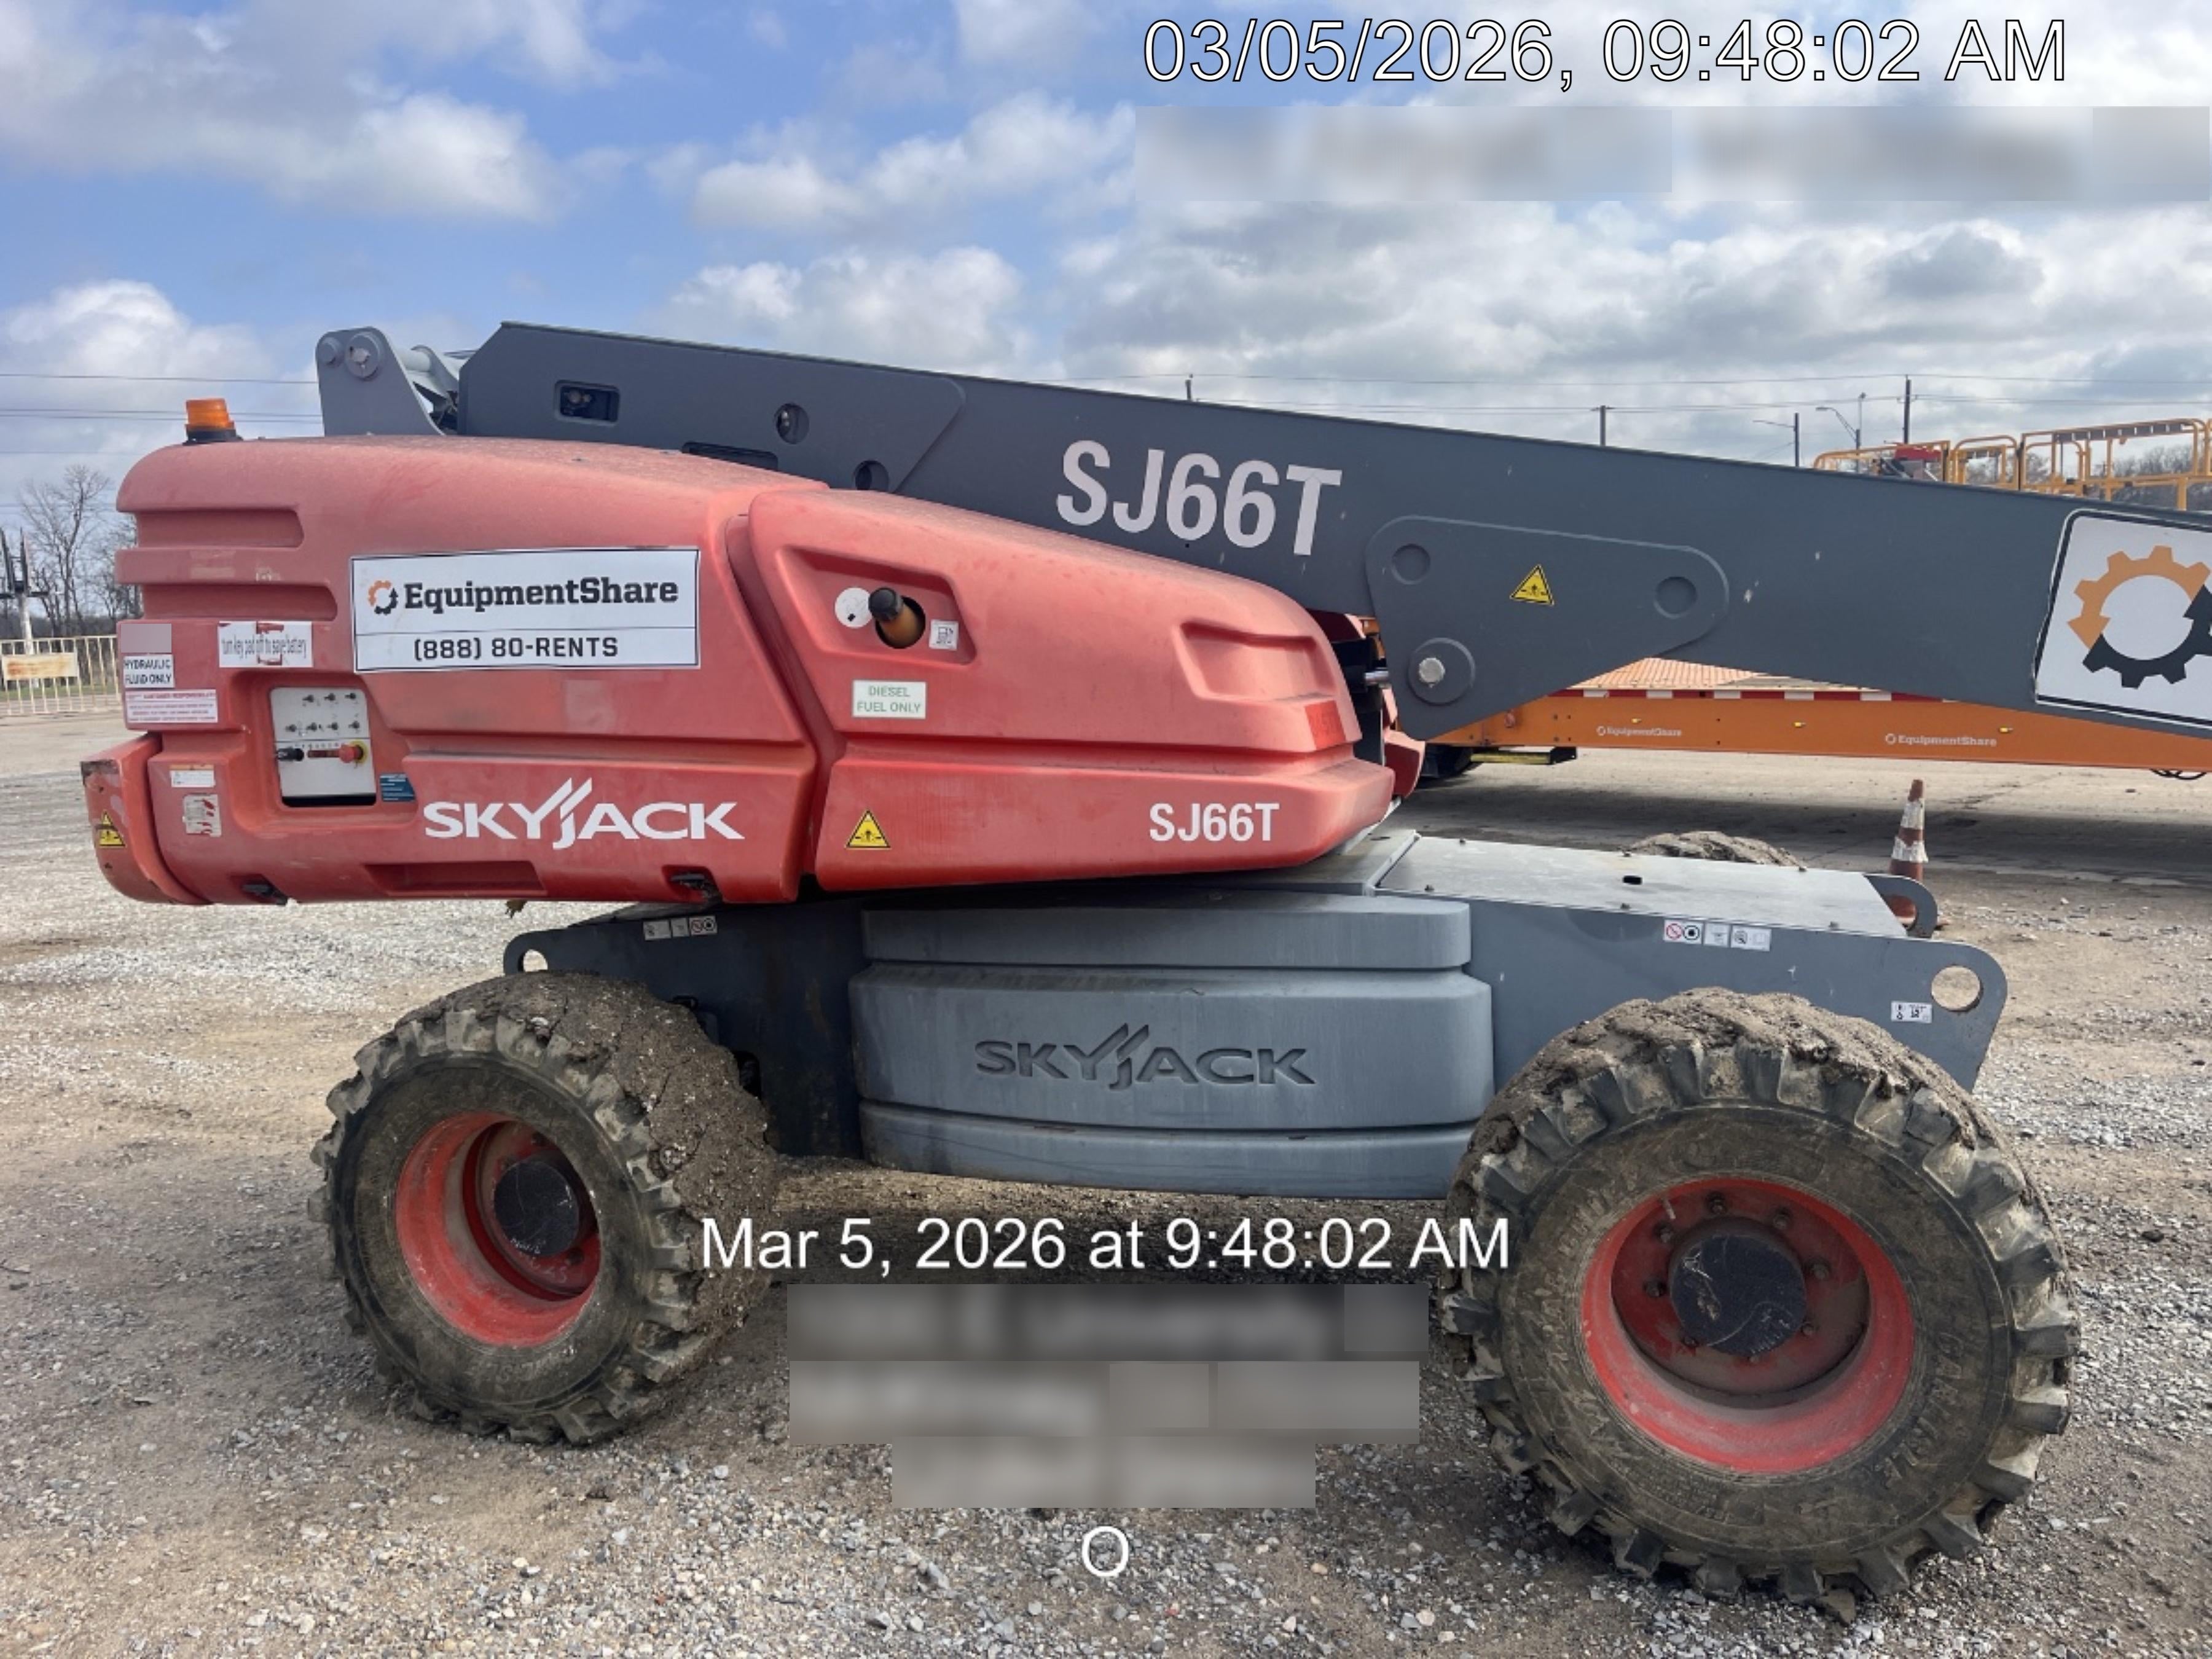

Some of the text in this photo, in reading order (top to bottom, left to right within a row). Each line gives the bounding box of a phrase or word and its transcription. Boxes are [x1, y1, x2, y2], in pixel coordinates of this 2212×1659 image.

[1056, 440, 1343, 555] SJ66T
[404, 577, 678, 614] EquipmentShare
[414, 637, 619, 662] (888) 80-RENTS
[125, 659, 171, 670] HYDRAULIC
[125, 673, 171, 684] FLUID ONLY
[868, 686, 910, 697] DIESEL
[857, 702, 921, 713] FUEL ONLY
[1897, 734, 1997, 747] EquipmentShare
[423, 777, 745, 850] SKYJACK
[1149, 802, 1280, 842] SJ66T
[975, 1022, 1317, 1090] SKYJACK
